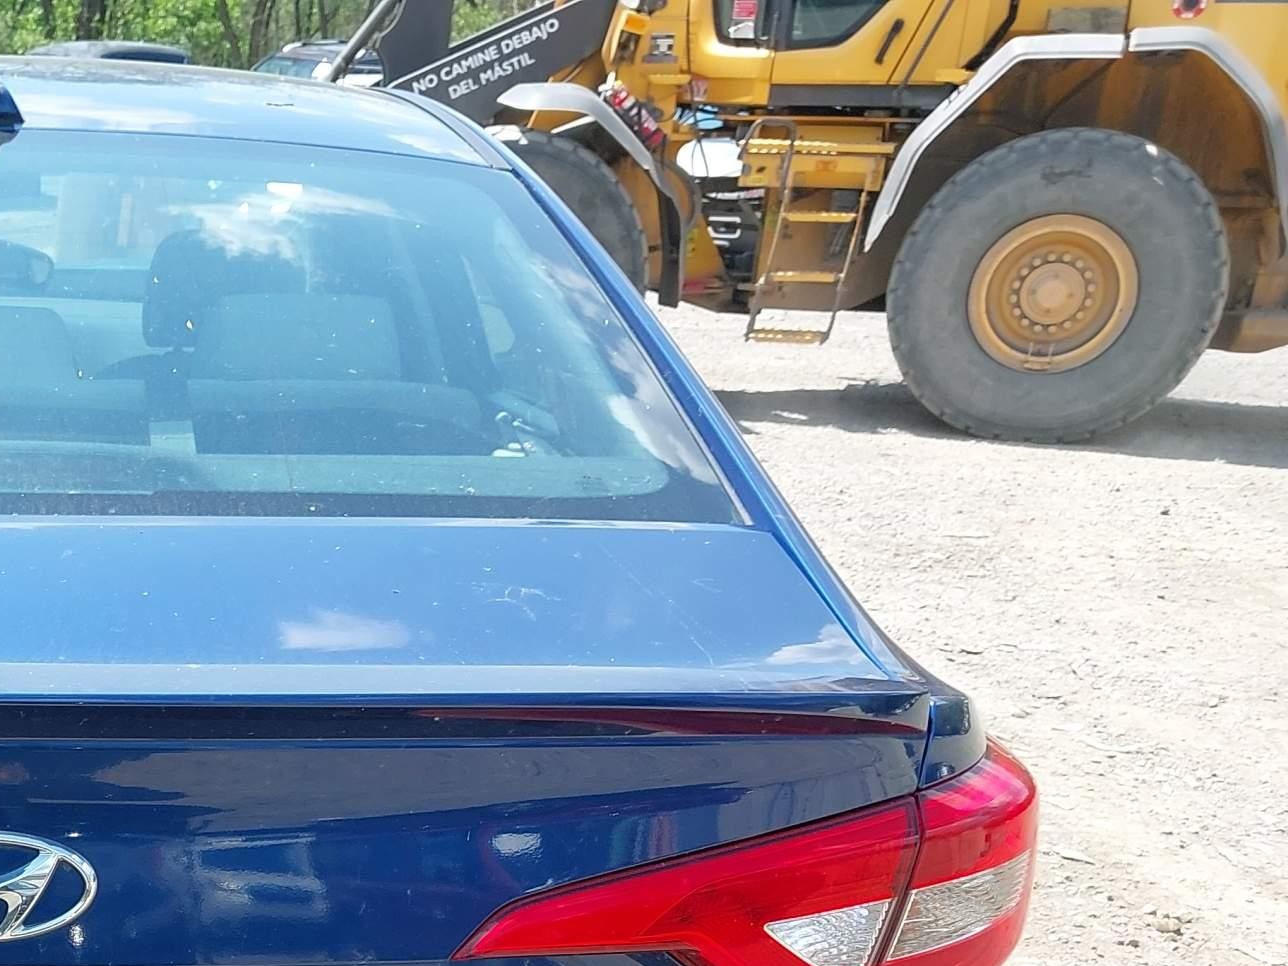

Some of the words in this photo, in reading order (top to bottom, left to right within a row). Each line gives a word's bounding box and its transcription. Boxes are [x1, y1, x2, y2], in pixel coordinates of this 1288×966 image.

[412, 74, 438, 94] NO
[440, 46, 499, 81] CAMINE
[501, 18, 559, 55] DEBAJO
[448, 81, 479, 100] DEL
[480, 52, 536, 86] MÁSTIL
